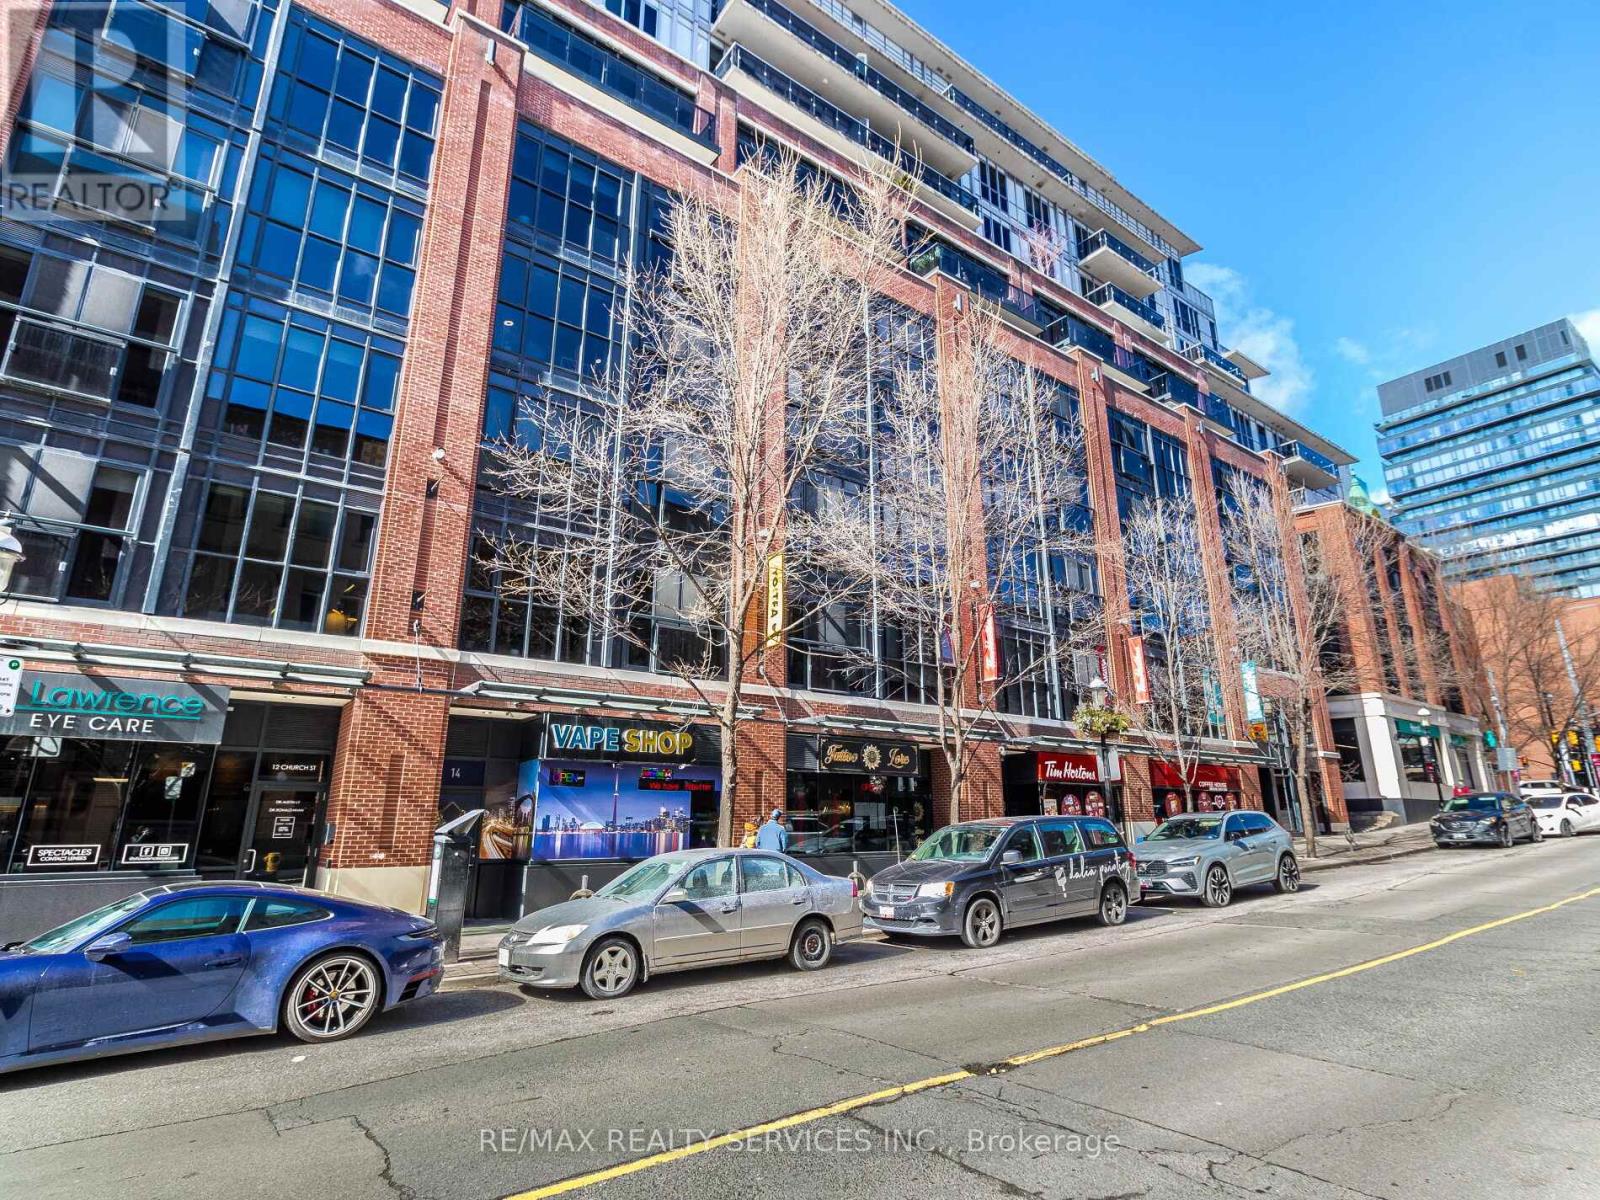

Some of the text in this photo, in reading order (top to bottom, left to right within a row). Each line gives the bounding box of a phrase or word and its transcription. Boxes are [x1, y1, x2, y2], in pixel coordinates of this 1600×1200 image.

[31, 680, 204, 714] Lawrence
[30, 713, 154, 733] EYE CARE
[551, 723, 693, 755] VAPE SHOP
[450, 767, 461, 778] 14
[1044, 760, 1096, 780] Tim Hortons
[37, 849, 92, 857] SPECTACLES
